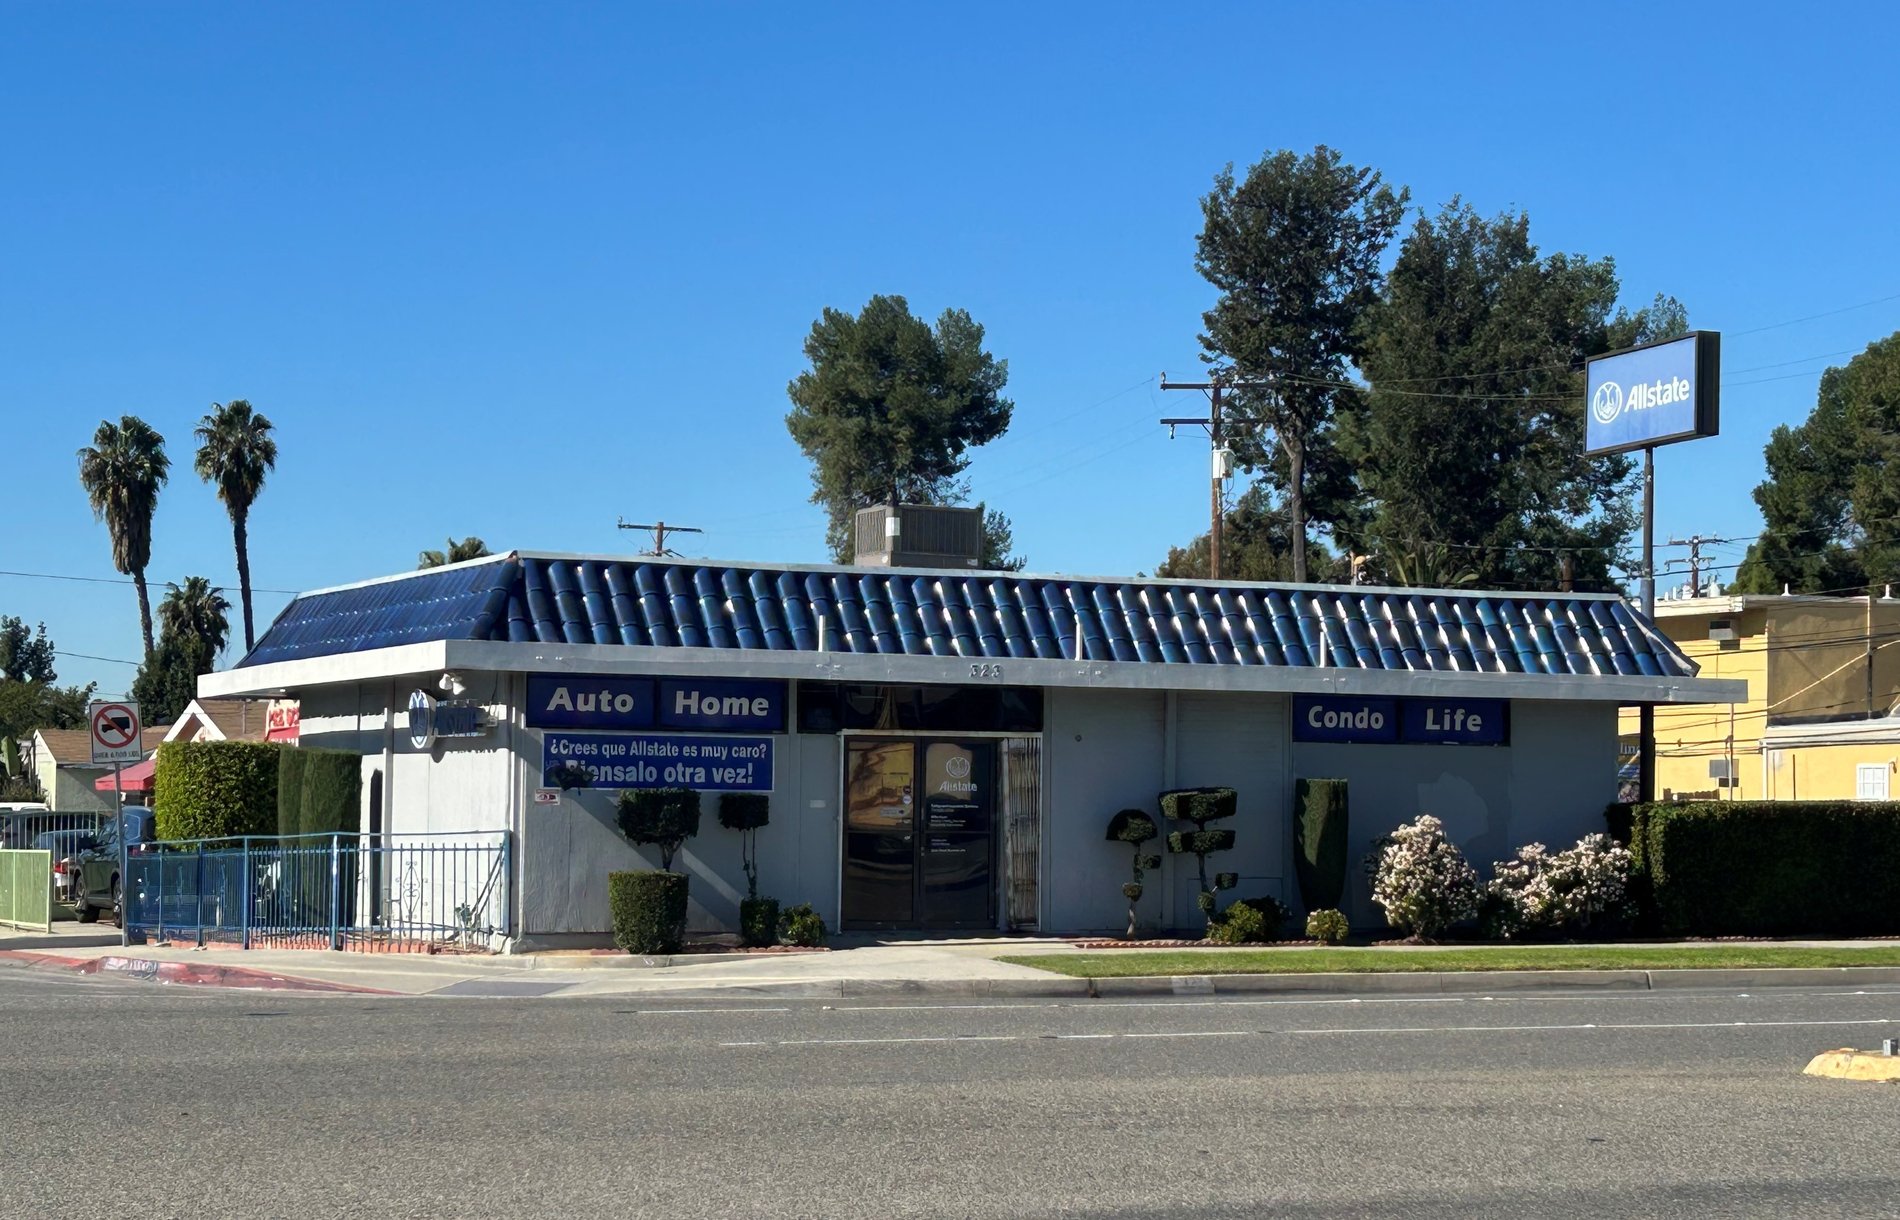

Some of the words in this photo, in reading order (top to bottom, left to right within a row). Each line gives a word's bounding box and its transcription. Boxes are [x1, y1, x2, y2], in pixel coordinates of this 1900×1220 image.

[1624, 376, 1690, 413] Allstate
[546, 687, 634, 713] Auto
[675, 690, 769, 717] Home
[1308, 705, 1384, 730] Condo
[1425, 708, 1482, 732] Life
[550, 739, 598, 755] ¿Crees
[602, 744, 626, 759] que
[630, 740, 680, 757] Allstate
[683, 745, 698, 757] es
[701, 745, 728, 761] muy
[732, 743, 767, 759] caro?
[664, 762, 706, 783] otra
[712, 763, 753, 784] vez!
